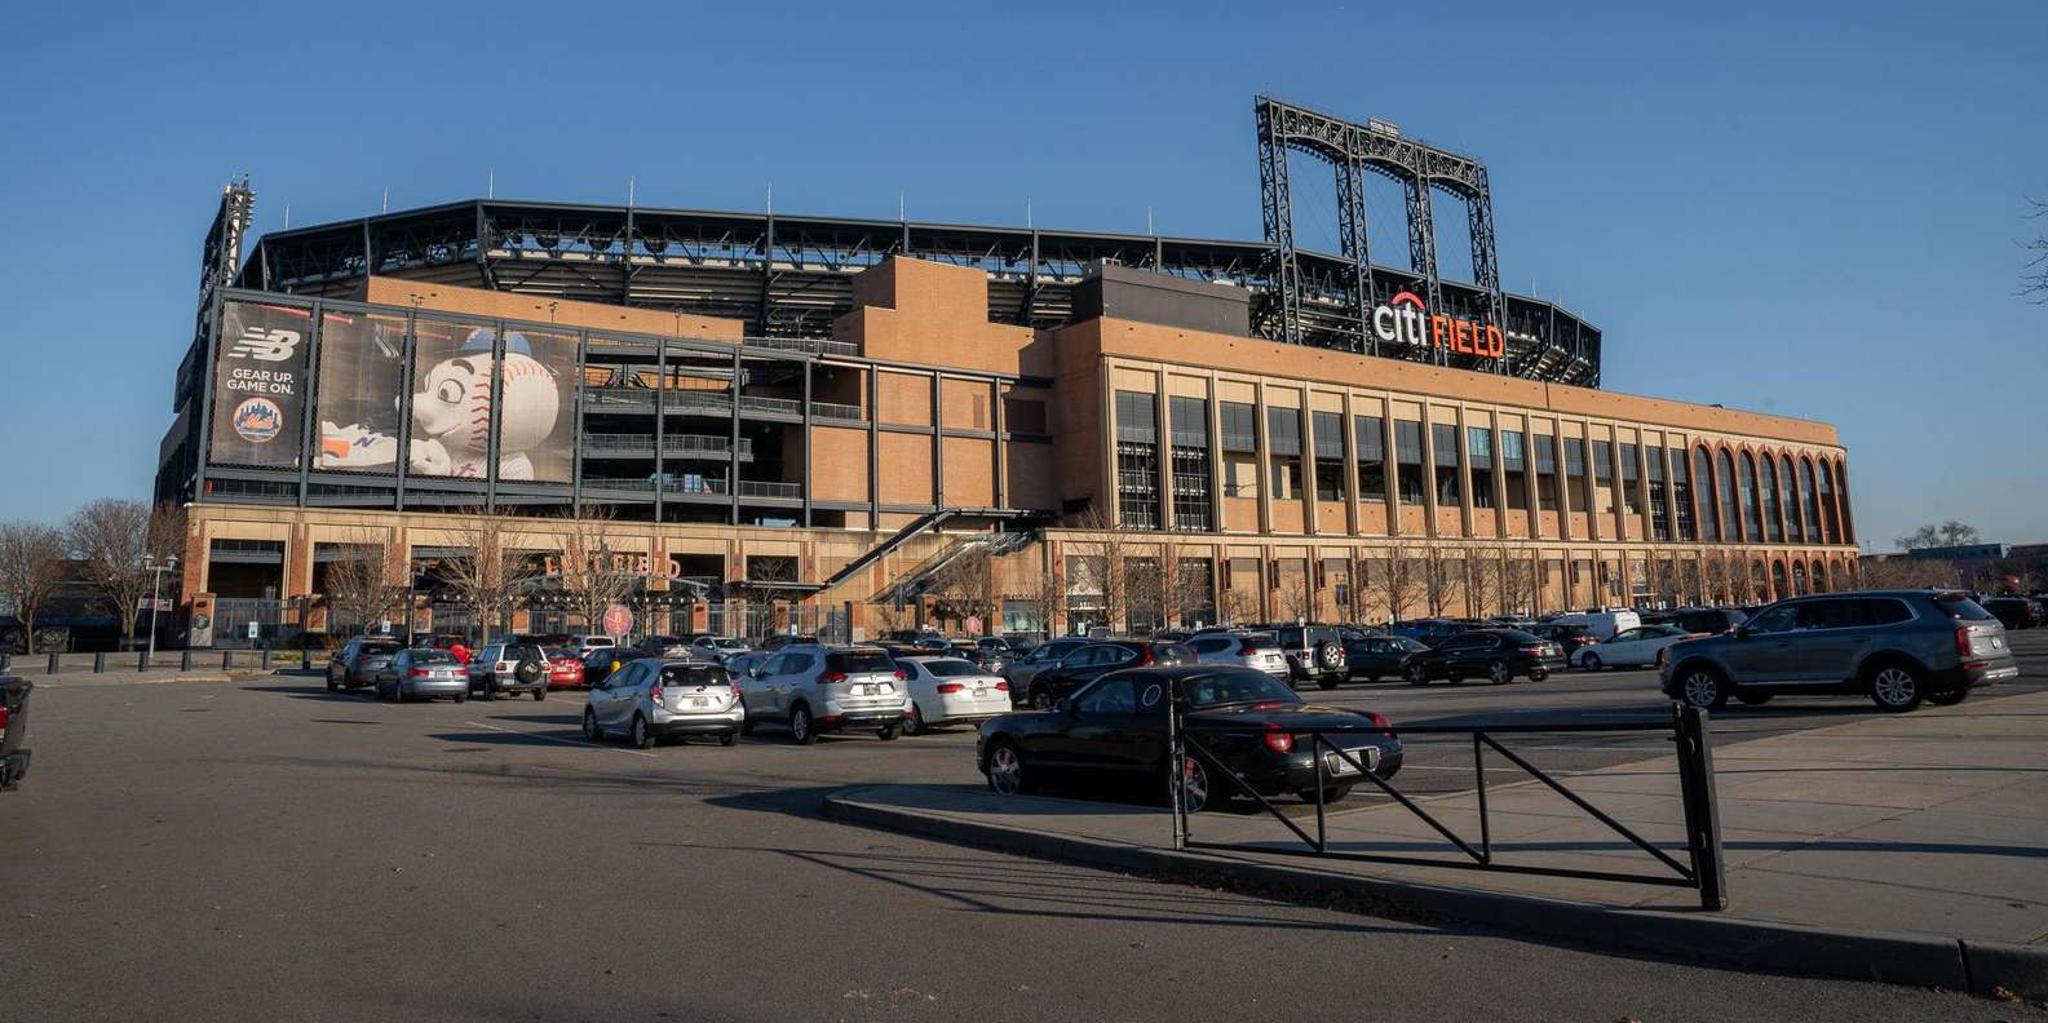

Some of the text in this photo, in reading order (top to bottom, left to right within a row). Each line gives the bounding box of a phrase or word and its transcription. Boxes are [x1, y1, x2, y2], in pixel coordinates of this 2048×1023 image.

[1430, 314, 1504, 358] FIELD
[232, 367, 295, 384] GEAR UP.
[227, 380, 295, 396] GAME ON.
